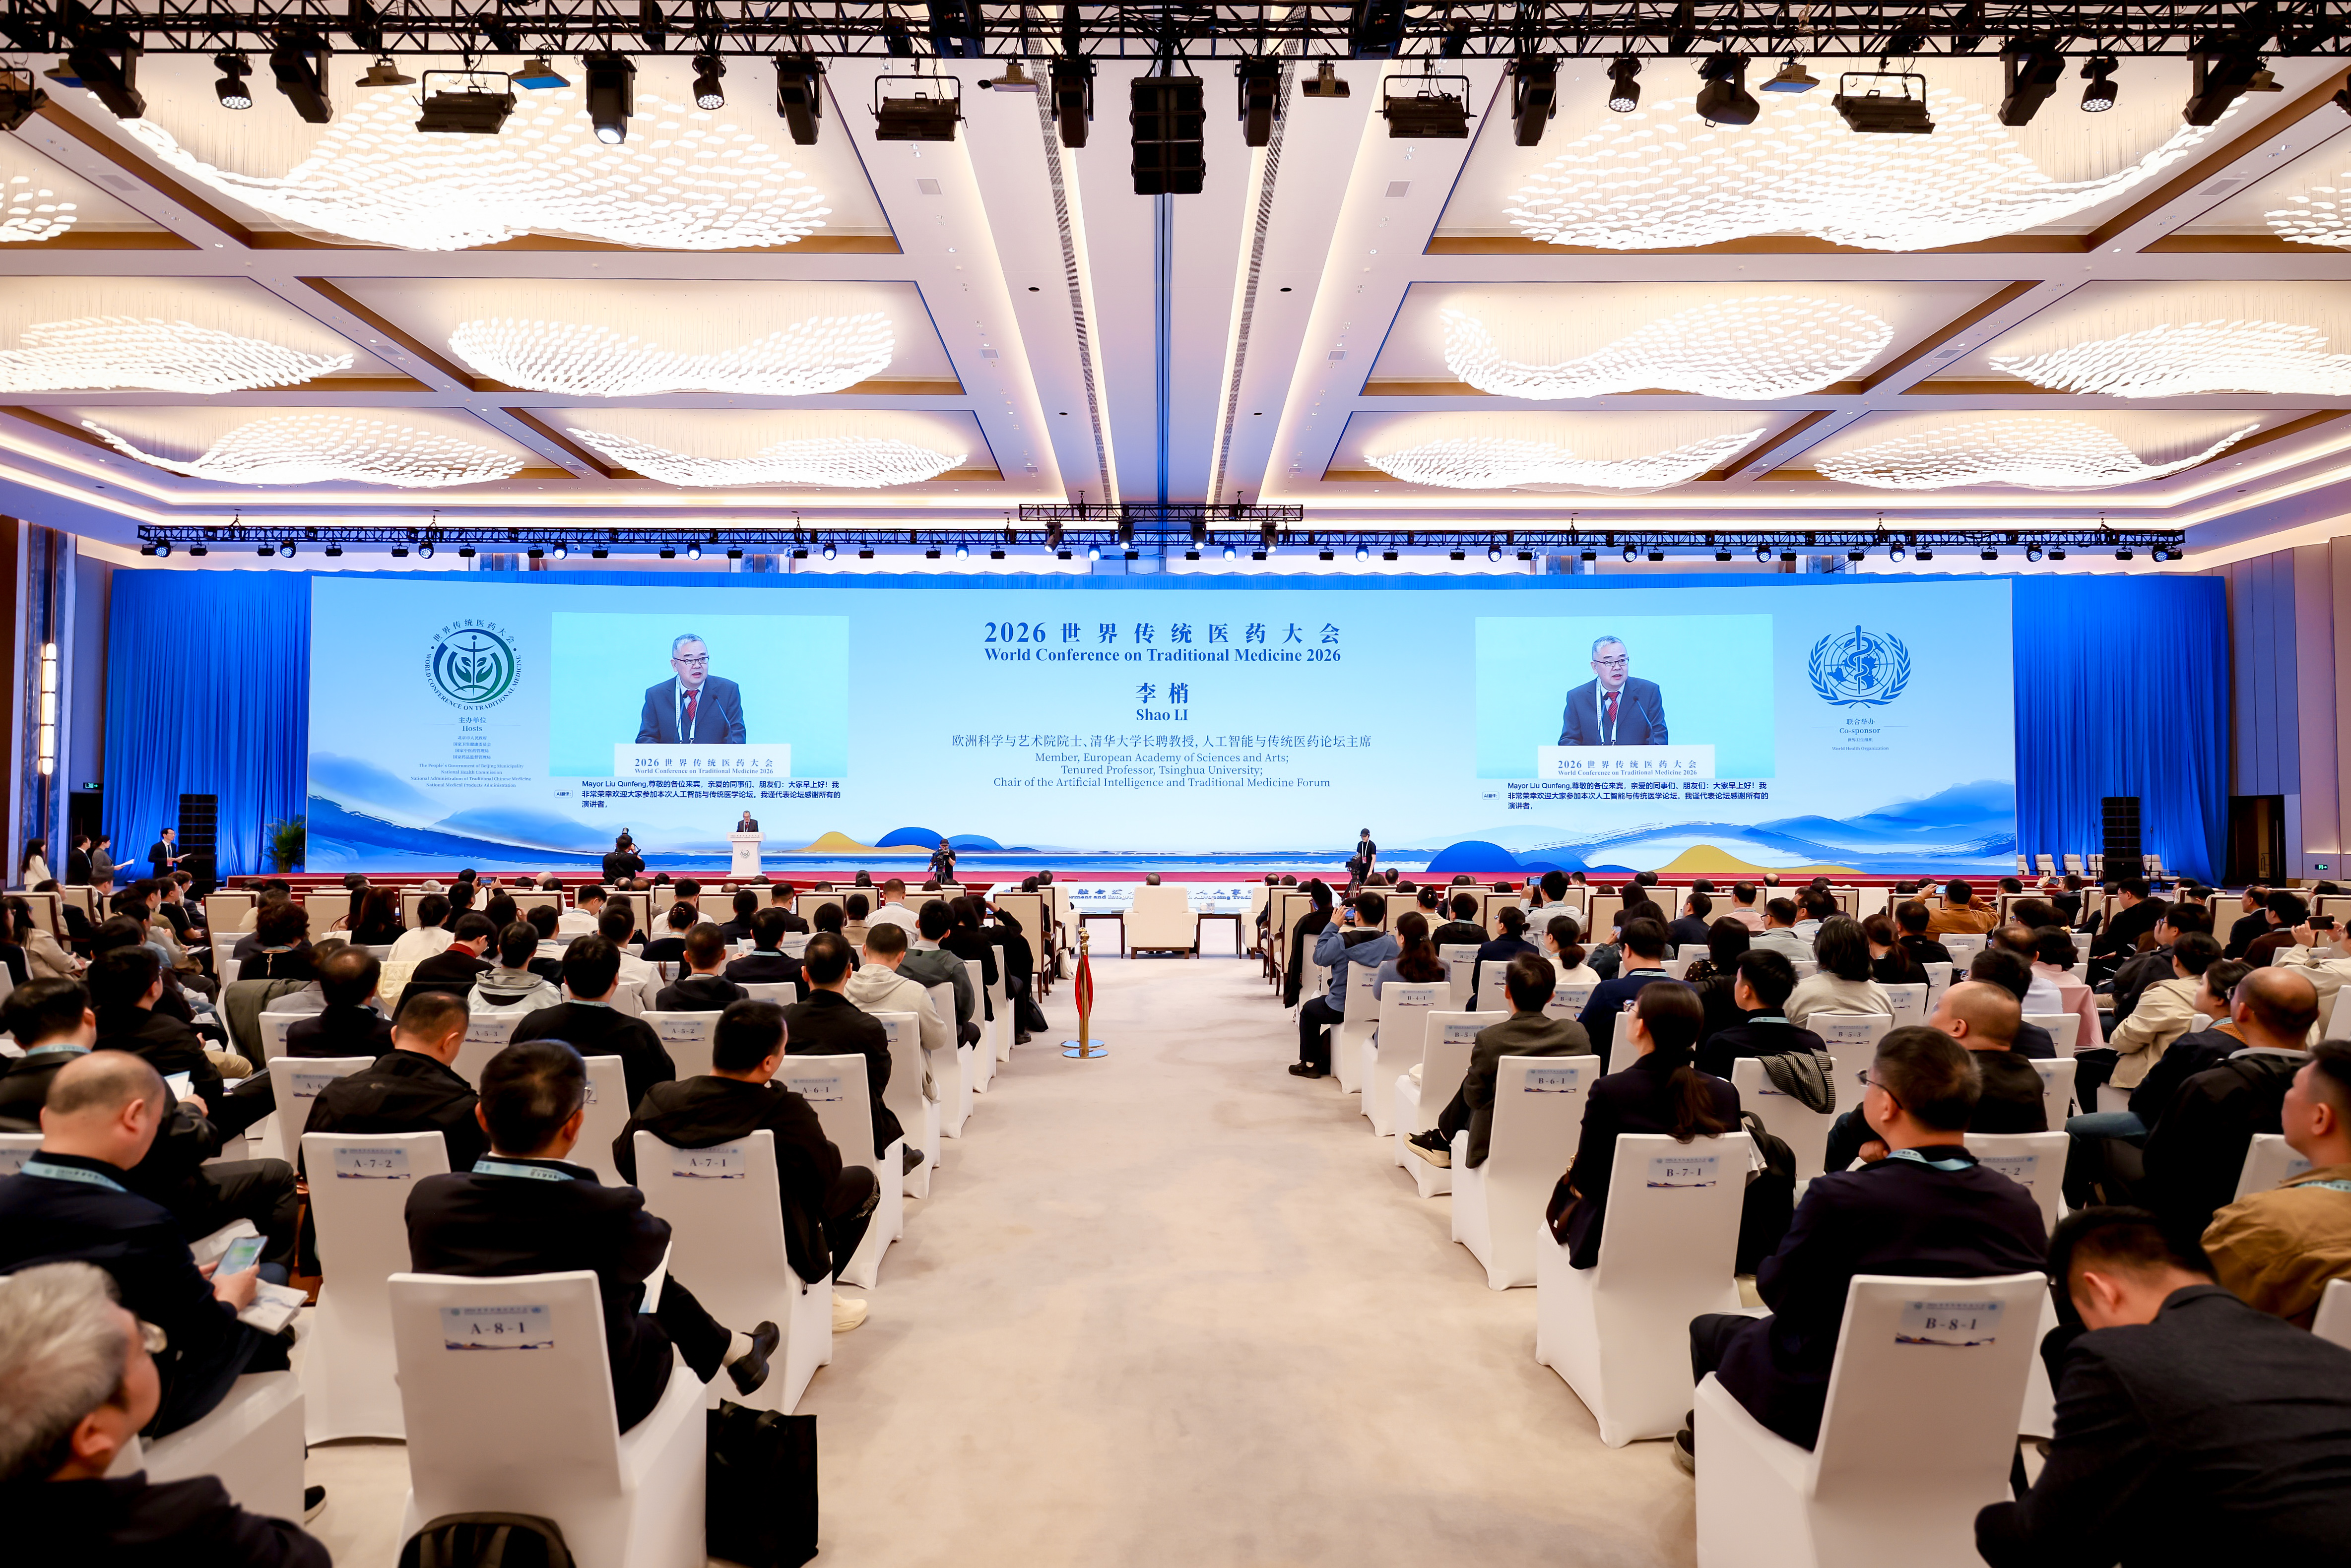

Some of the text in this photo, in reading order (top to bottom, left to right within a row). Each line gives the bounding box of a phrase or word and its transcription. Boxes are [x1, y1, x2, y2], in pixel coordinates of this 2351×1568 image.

[433, 619, 516, 644] 世界传统医药大会
[984, 622, 1340, 644] 2026 世界传统医药大会
[984, 648, 1341, 662] World Conference on Traditional Medicine 2026
[427, 678, 462, 709] CONFERENCE
[474, 687, 516, 711] TRADITIONAL
[512, 654, 522, 688] MEDICINE
[1136, 708, 1188, 721] Shao LI
[635, 758, 773, 767] 2026 世界传统医药大会
[1035, 752, 1289, 764] Member, European Academy of Sciences and Arts;
[1558, 759, 1697, 769] 2026 世界传统医药大会
[1061, 764, 1262, 777] Tenured Professor, Tsinghua University;
[582, 780, 604, 789] Mayor
[993, 777, 1330, 789] Chair of the Artificial Intelligence and Traditional Medicine Forum
[354, 1159, 392, 1168] A-7-2
[690, 1158, 726, 1167] A-7-1
[1666, 1168, 1701, 1177] B-7-1
[470, 1321, 526, 1334] A-8-1
[1925, 1317, 1976, 1330] B-8-1
